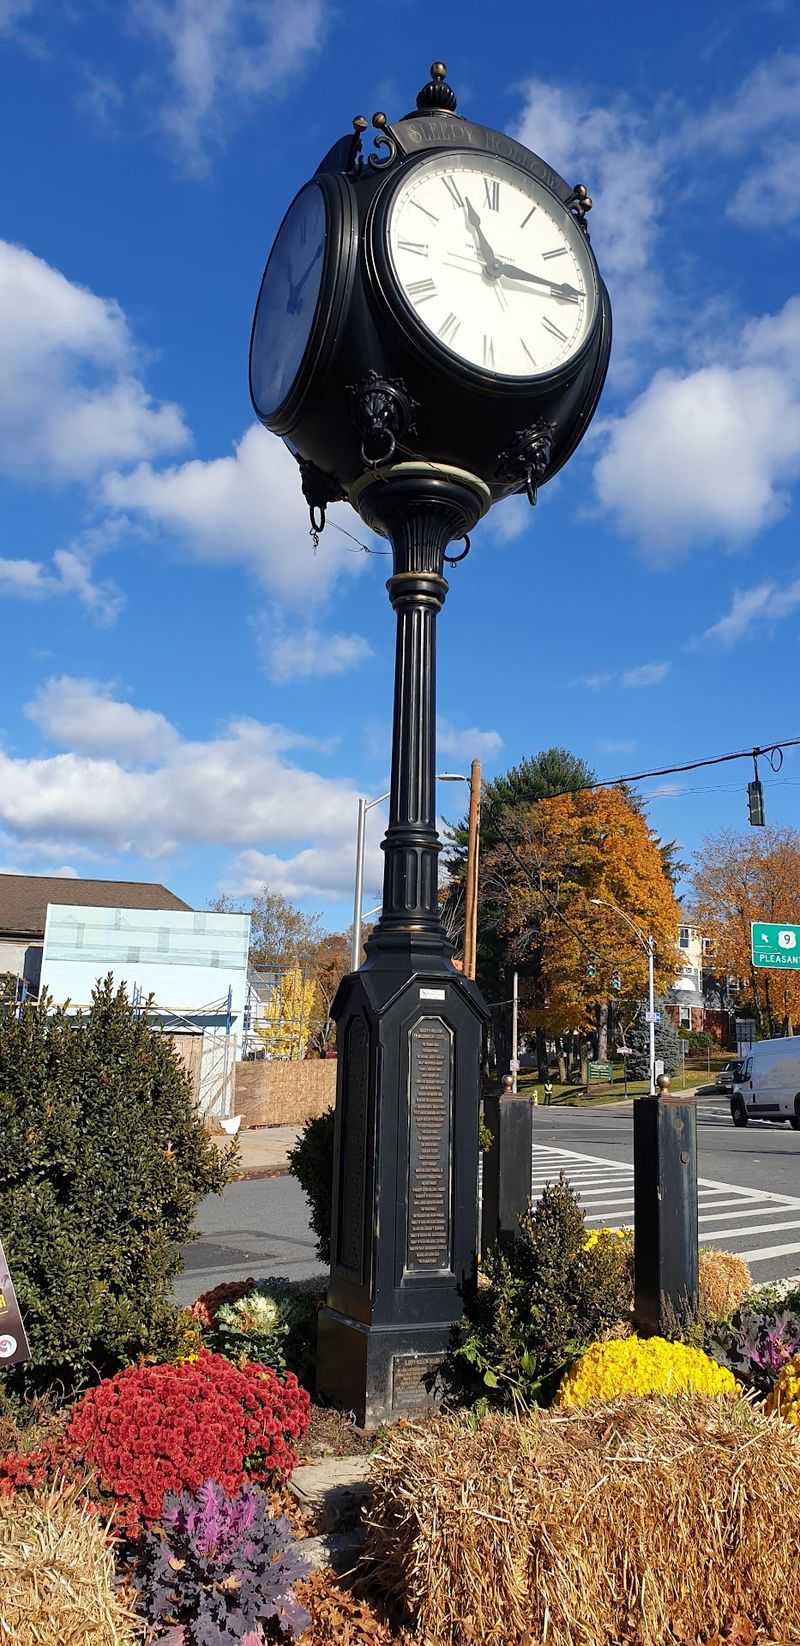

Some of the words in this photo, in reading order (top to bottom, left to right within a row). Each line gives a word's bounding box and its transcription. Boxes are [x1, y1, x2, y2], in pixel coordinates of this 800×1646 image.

[407, 118, 473, 144] SLEEPY
[784, 934, 791, 945] 9
[759, 954, 800, 965] PLEASAN
